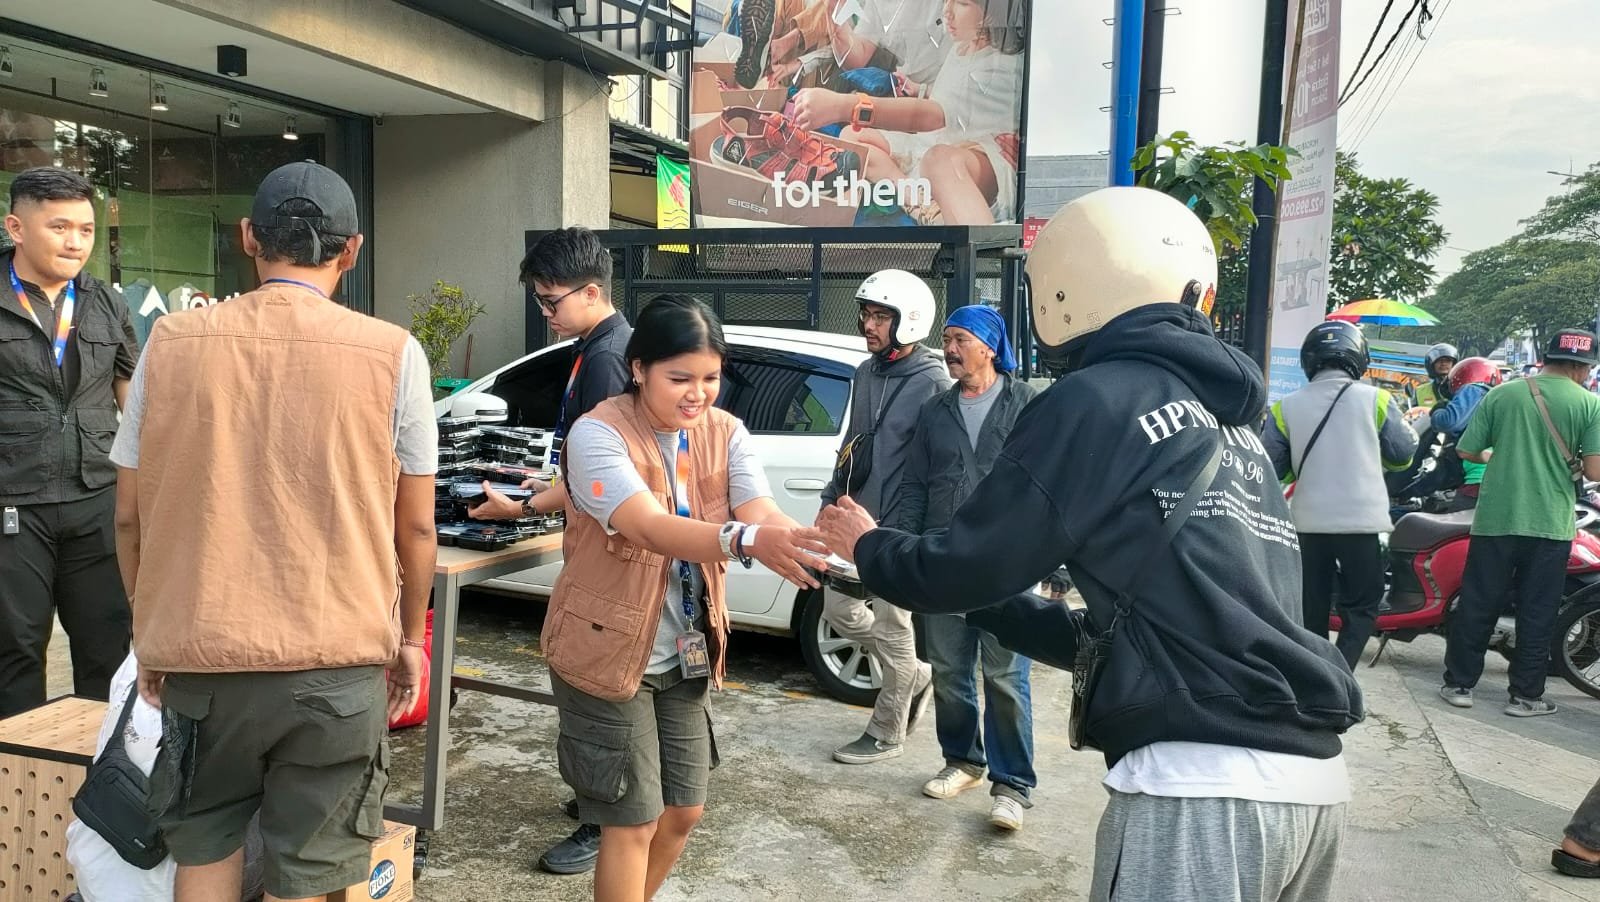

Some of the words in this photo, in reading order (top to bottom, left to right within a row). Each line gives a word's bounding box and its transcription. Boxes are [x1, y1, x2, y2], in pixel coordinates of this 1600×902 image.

[771, 171, 824, 208] for
[833, 171, 931, 207] them
[727, 198, 769, 215] EIGER
[1244, 461, 1264, 484] 96
[1152, 488, 1170, 498] You
[1211, 508, 1225, 516] the
